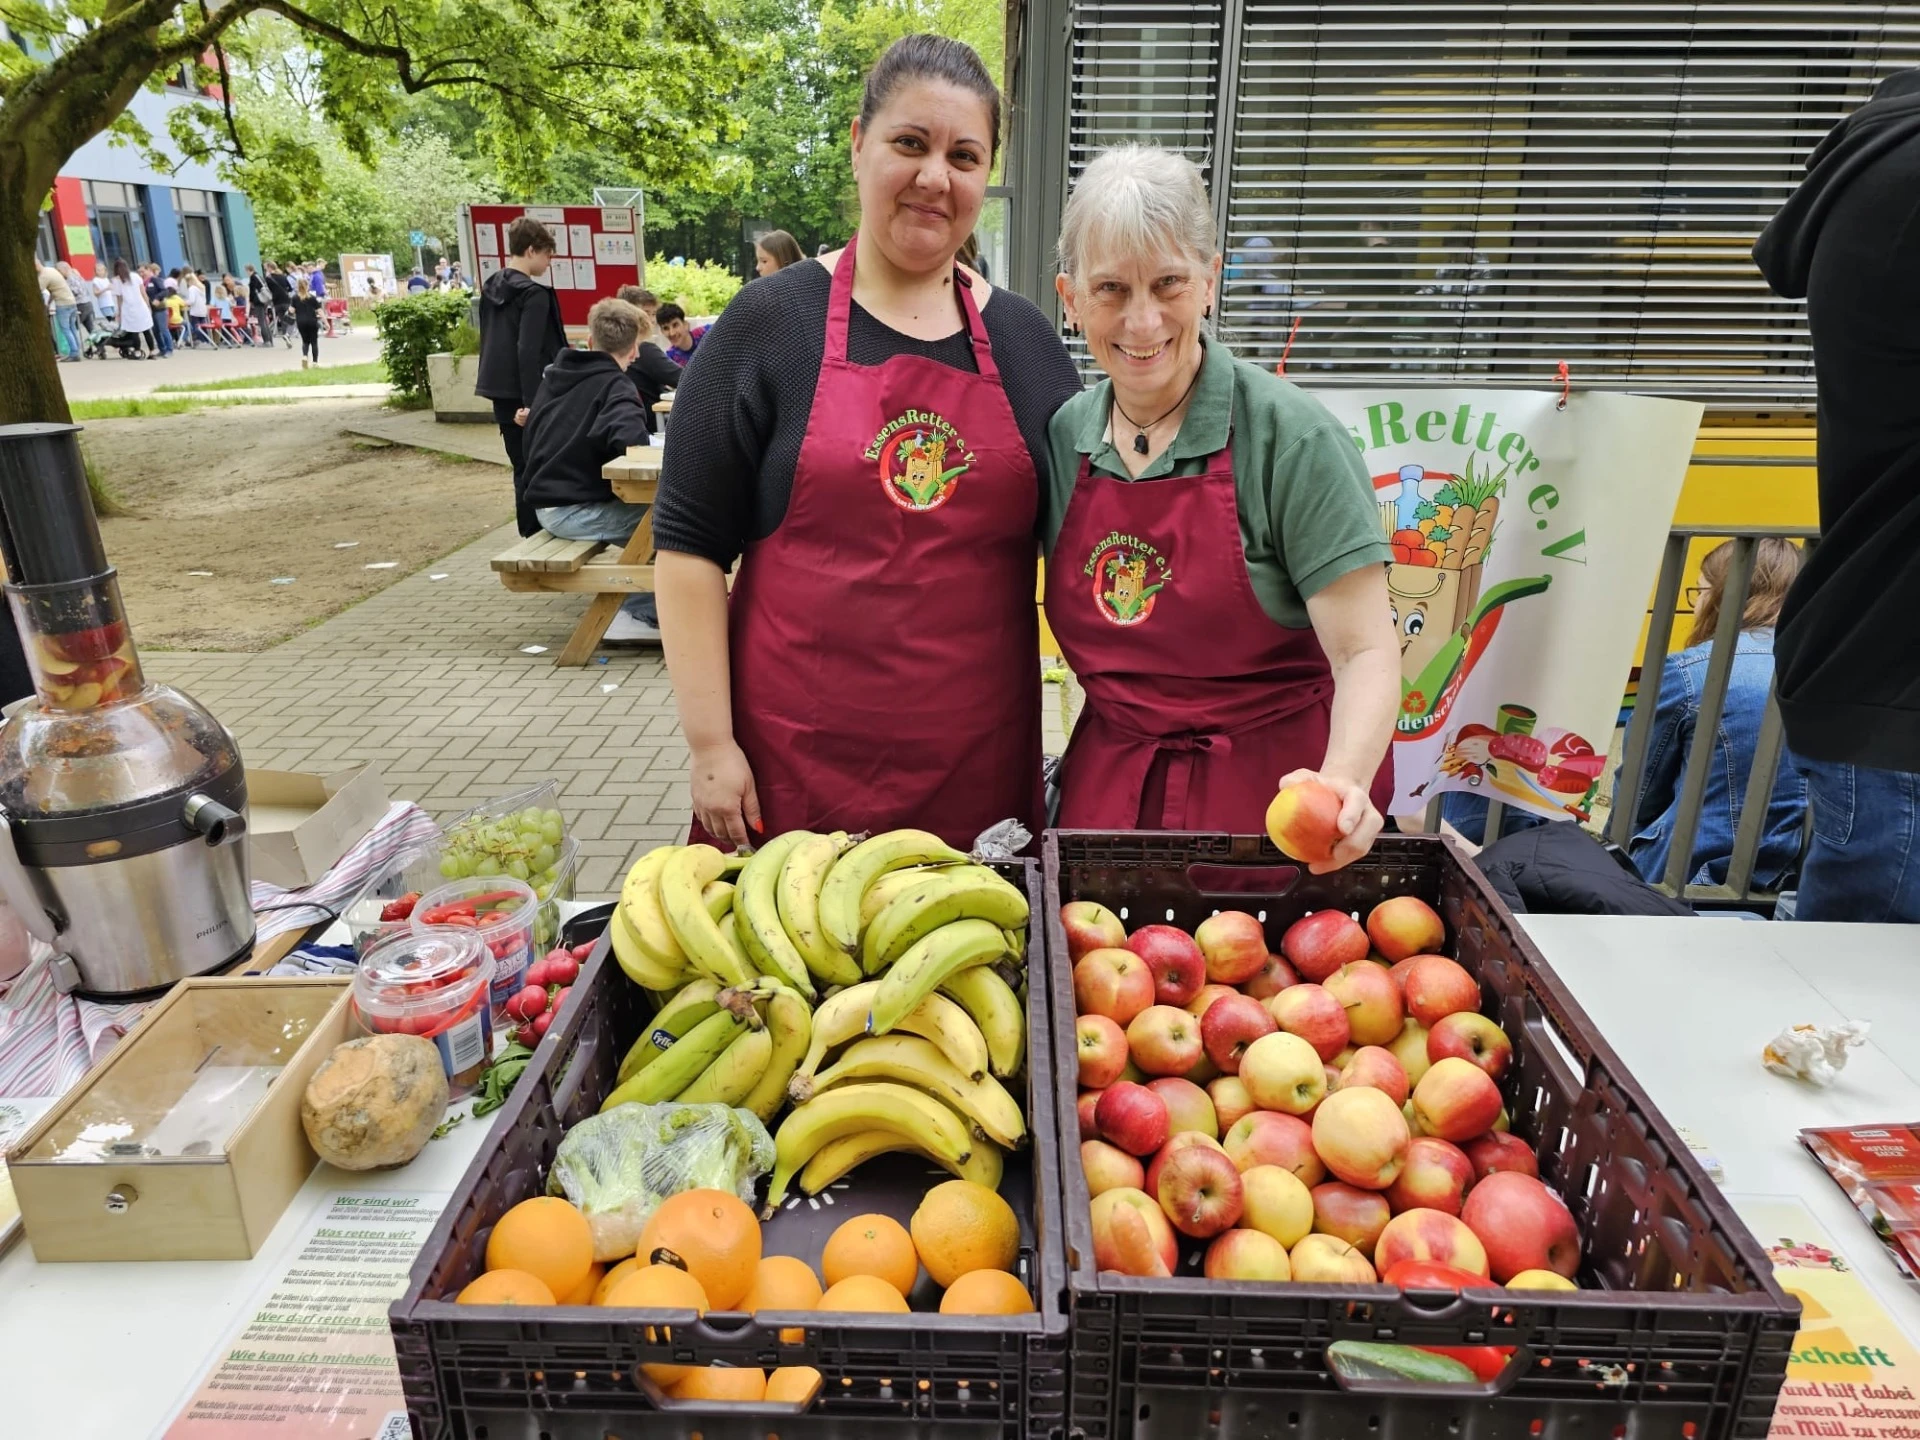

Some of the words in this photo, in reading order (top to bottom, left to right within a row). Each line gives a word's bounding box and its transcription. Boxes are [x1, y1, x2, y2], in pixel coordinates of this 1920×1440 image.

[864, 409, 958, 461] EssensRetter
[1084, 531, 1157, 577] EssensRetter
[336, 1197, 360, 1205] Wer
[363, 1197, 391, 1206] sind
[393, 1198, 419, 1207] wir?
[316, 1228, 343, 1238] Was
[345, 1229, 385, 1239] retten
[388, 1230, 416, 1240] wir?
[256, 1311, 284, 1321] Wer
[287, 1313, 318, 1322] darf
[318, 1315, 361, 1324] retten
[230, 1350, 256, 1360] Wie
[258, 1350, 296, 1362] kann
[298, 1352, 319, 1363] ich
[1783, 1382, 1822, 1397] und
[1822, 1382, 1859, 1401] hilf
[1861, 1384, 1916, 1400] dabei
[1776, 1404, 1838, 1417] onnen
[1795, 1420, 1850, 1437] Müll
[1851, 1427, 1877, 1438] zu
